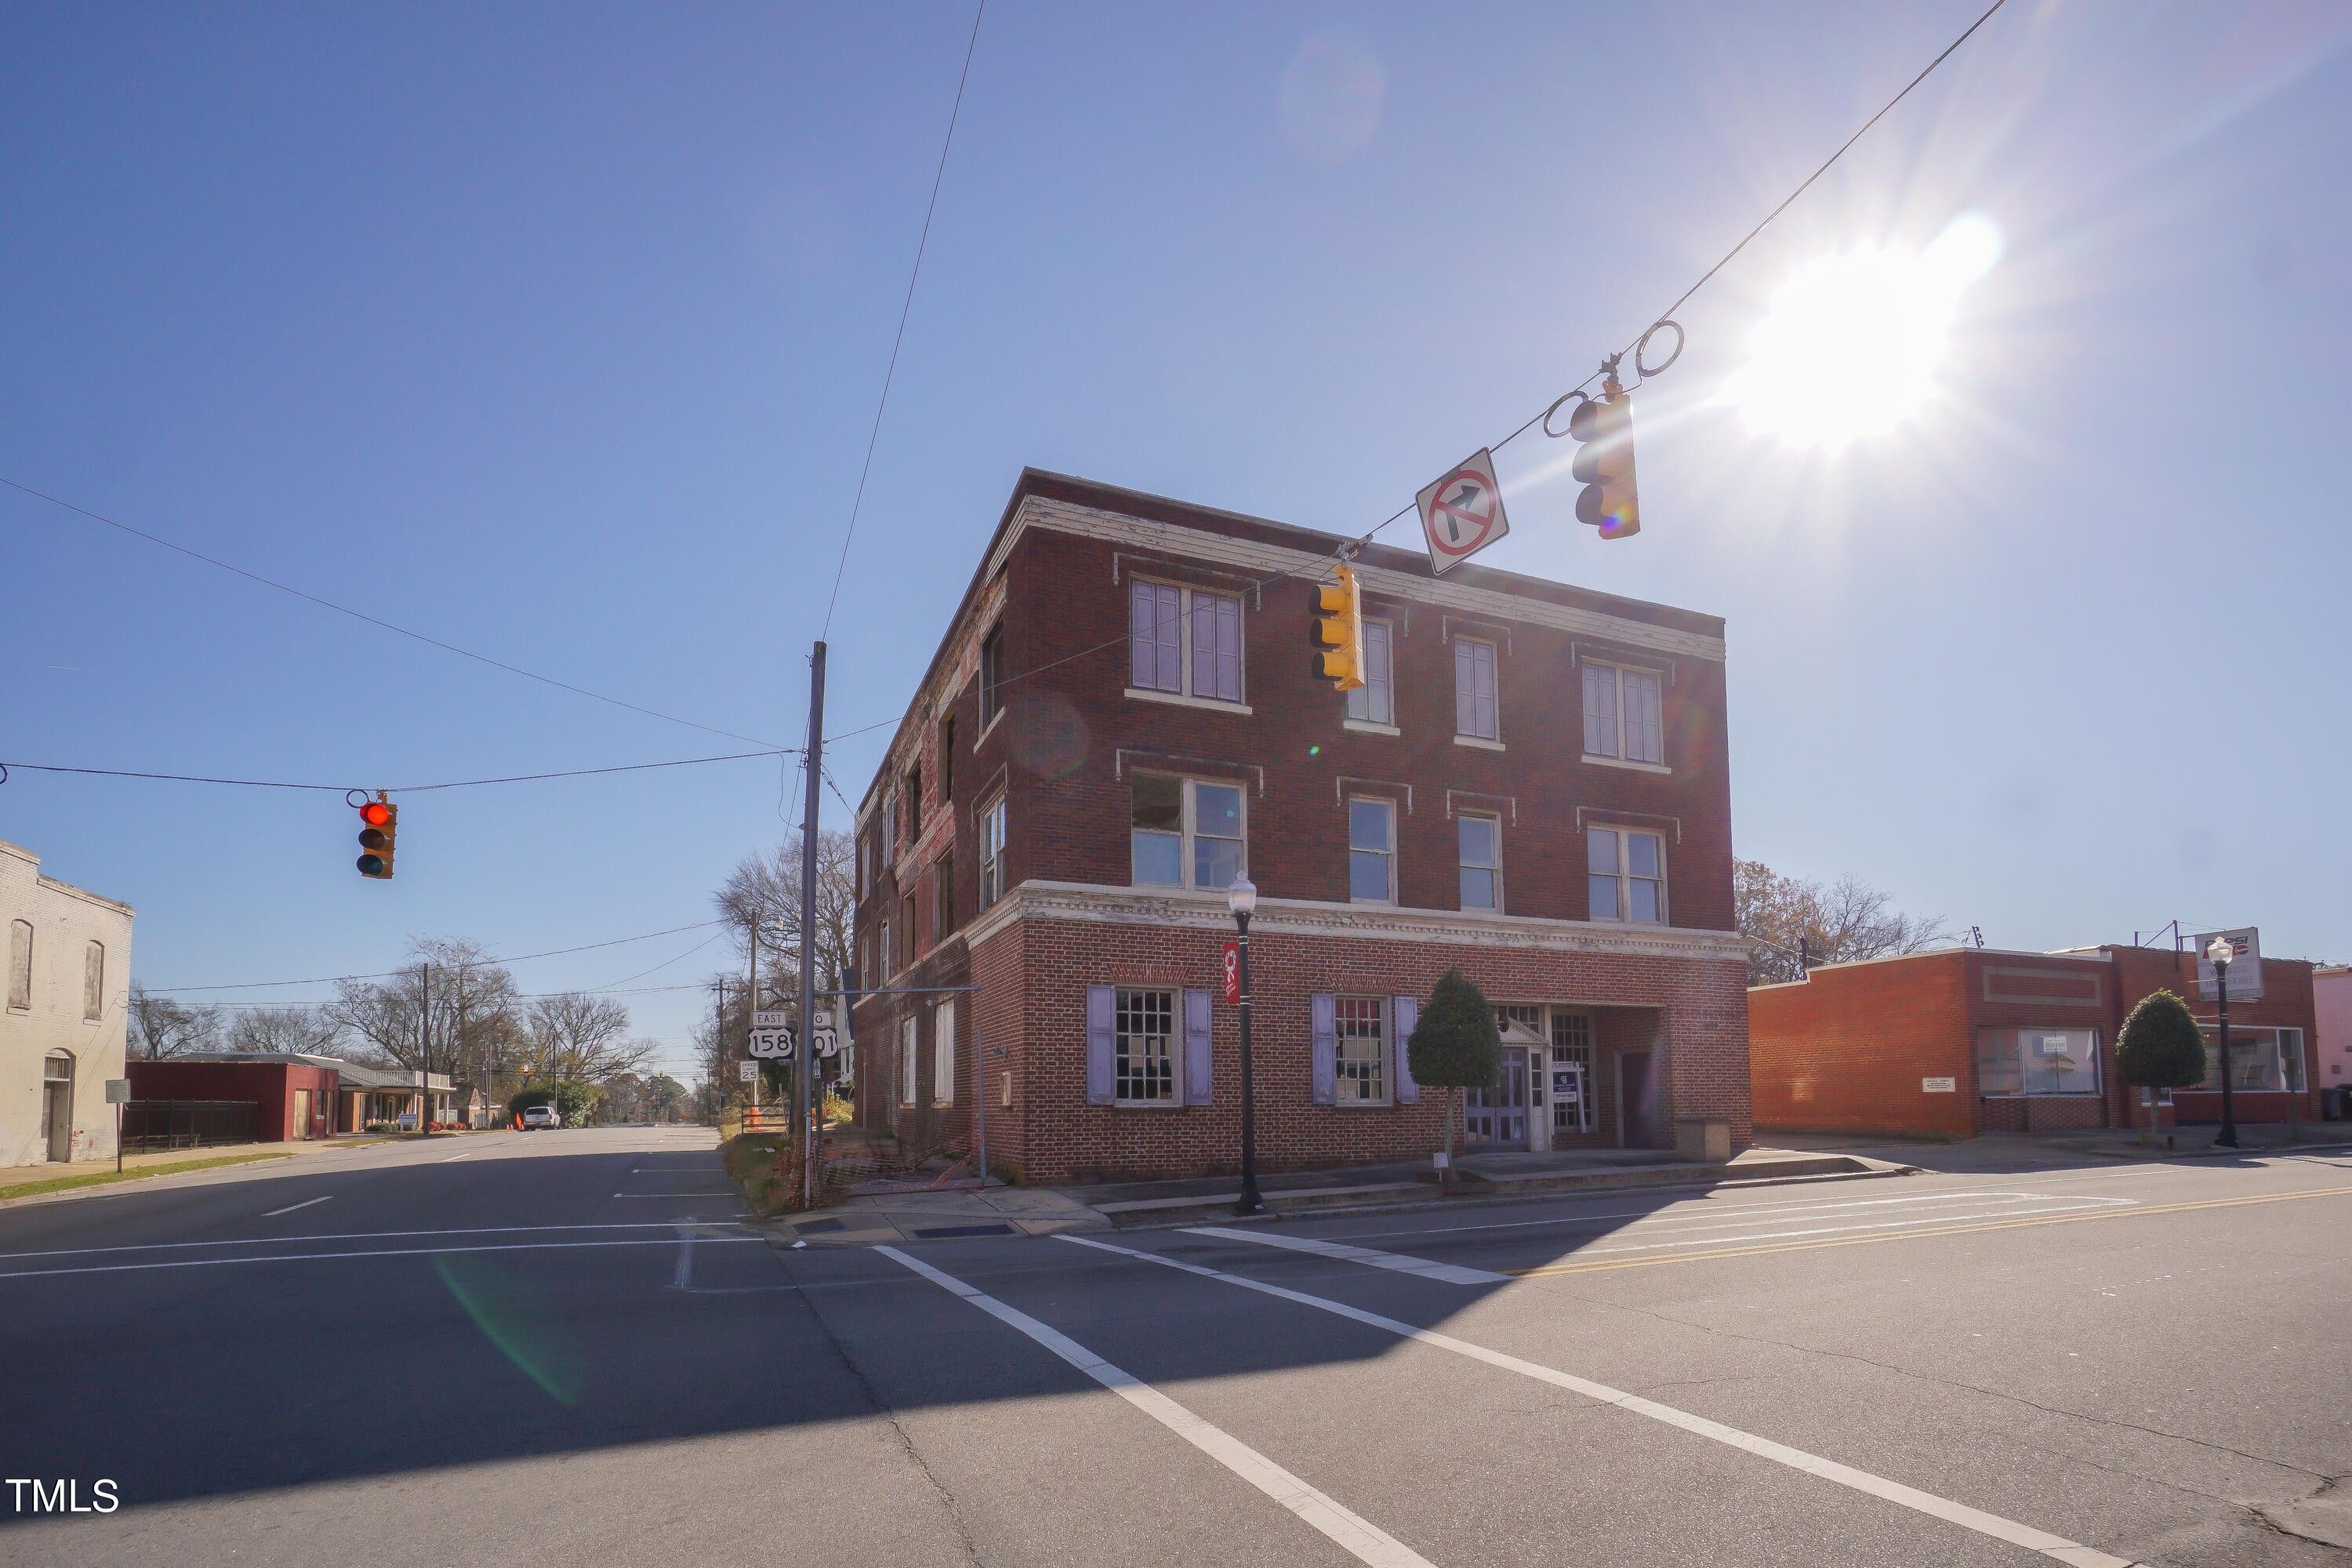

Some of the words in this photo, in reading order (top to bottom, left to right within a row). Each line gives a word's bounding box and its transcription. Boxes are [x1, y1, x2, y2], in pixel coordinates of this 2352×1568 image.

[757, 1014, 782, 1023] EAST
[815, 1014, 823, 1024] O
[753, 1034, 789, 1052] 158
[813, 1035, 834, 1052] 01
